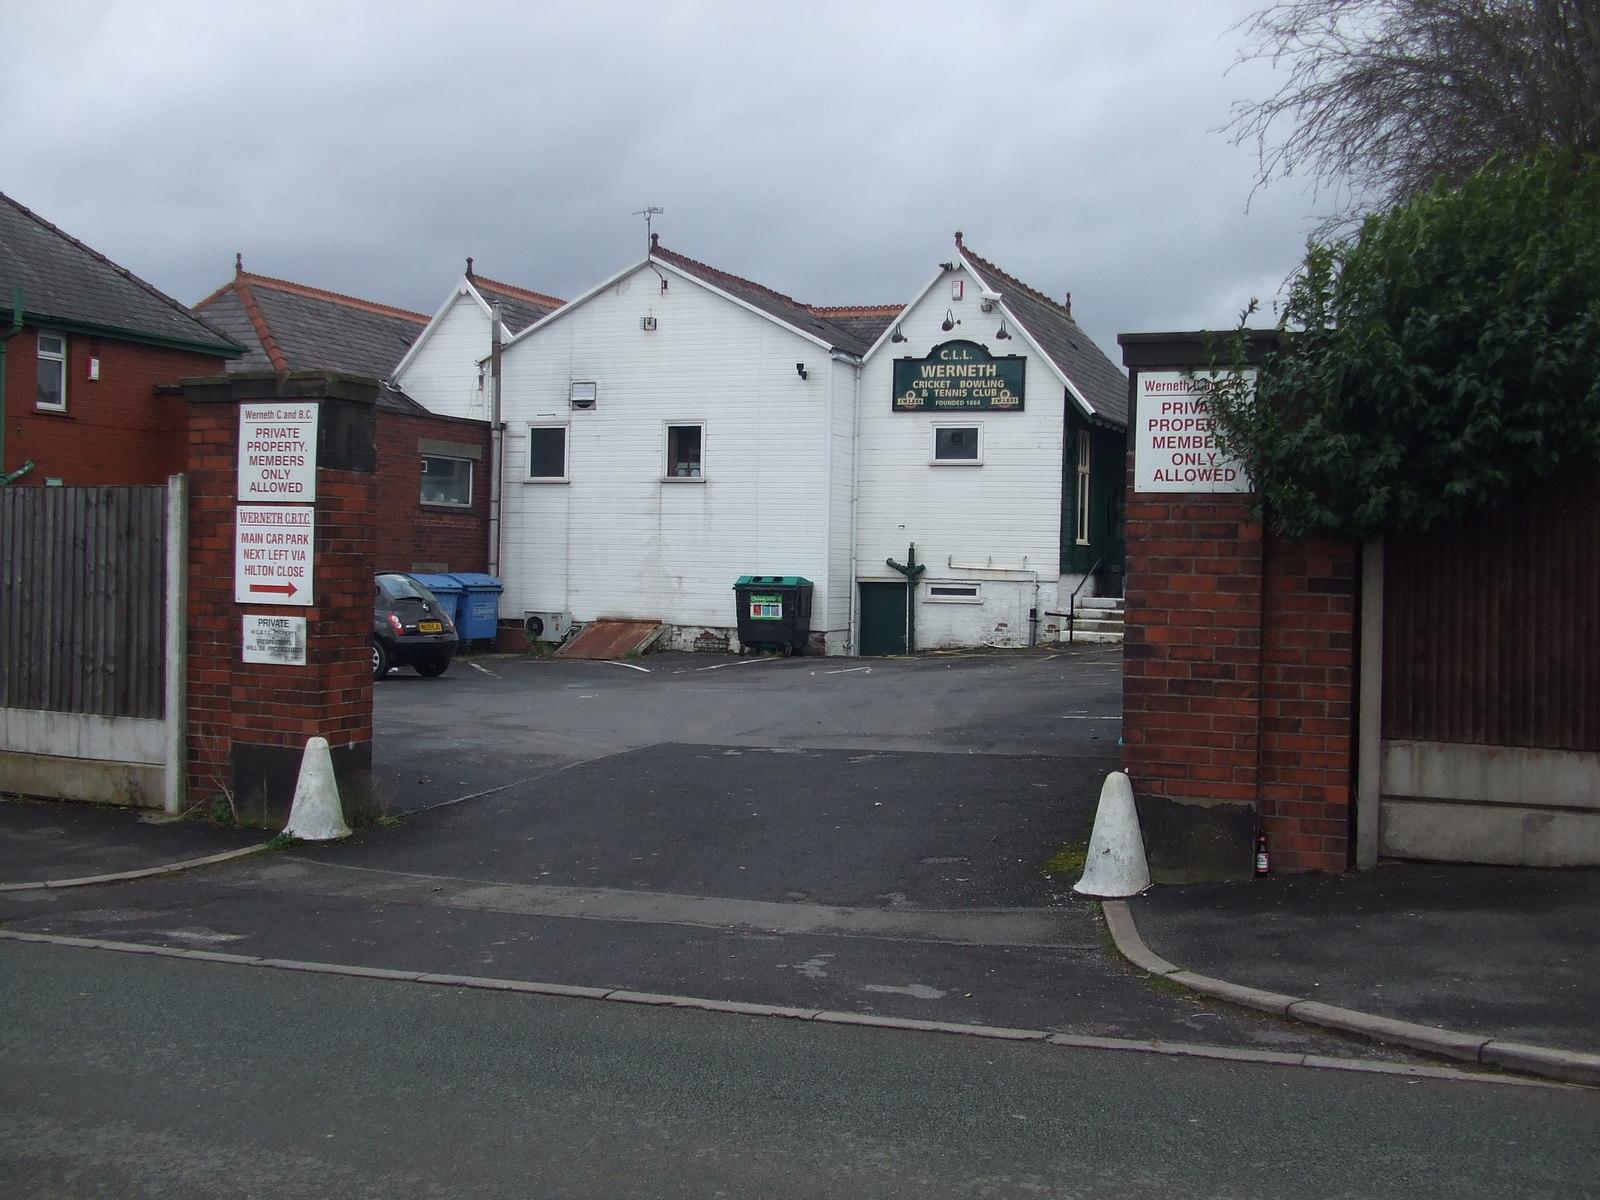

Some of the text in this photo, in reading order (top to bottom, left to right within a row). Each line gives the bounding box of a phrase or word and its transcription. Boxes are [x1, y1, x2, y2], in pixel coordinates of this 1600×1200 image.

[941, 350, 972, 360] C.L.L.
[921, 364, 997, 377] WERNETH
[912, 380, 1005, 388] CRICKET BOWLING
[1144, 380, 1189, 392] Werneth
[921, 388, 997, 397] & TENNIS CLUB
[245, 409, 274, 420] Werneth
[284, 409, 296, 420] and
[298, 409, 313, 420] B.C.
[255, 428, 300, 439] PRIVATE
[246, 441, 308, 452] PROPERTY.
[249, 455, 304, 466] MEMBERS
[1171, 452, 1217, 466] ONLY
[261, 469, 291, 480] ONLY
[1153, 469, 1236, 482] ALLOWED
[249, 482, 303, 493] ALLOWED
[240, 511, 311, 525] WERNETH C.B.T.C.
[241, 532, 309, 545] MAIN CAR PARK
[243, 549, 306, 561] NEXT LEFT VIA
[244, 565, 304, 577] HILTON CLOSE
[258, 618, 290, 628] PRIVATE
